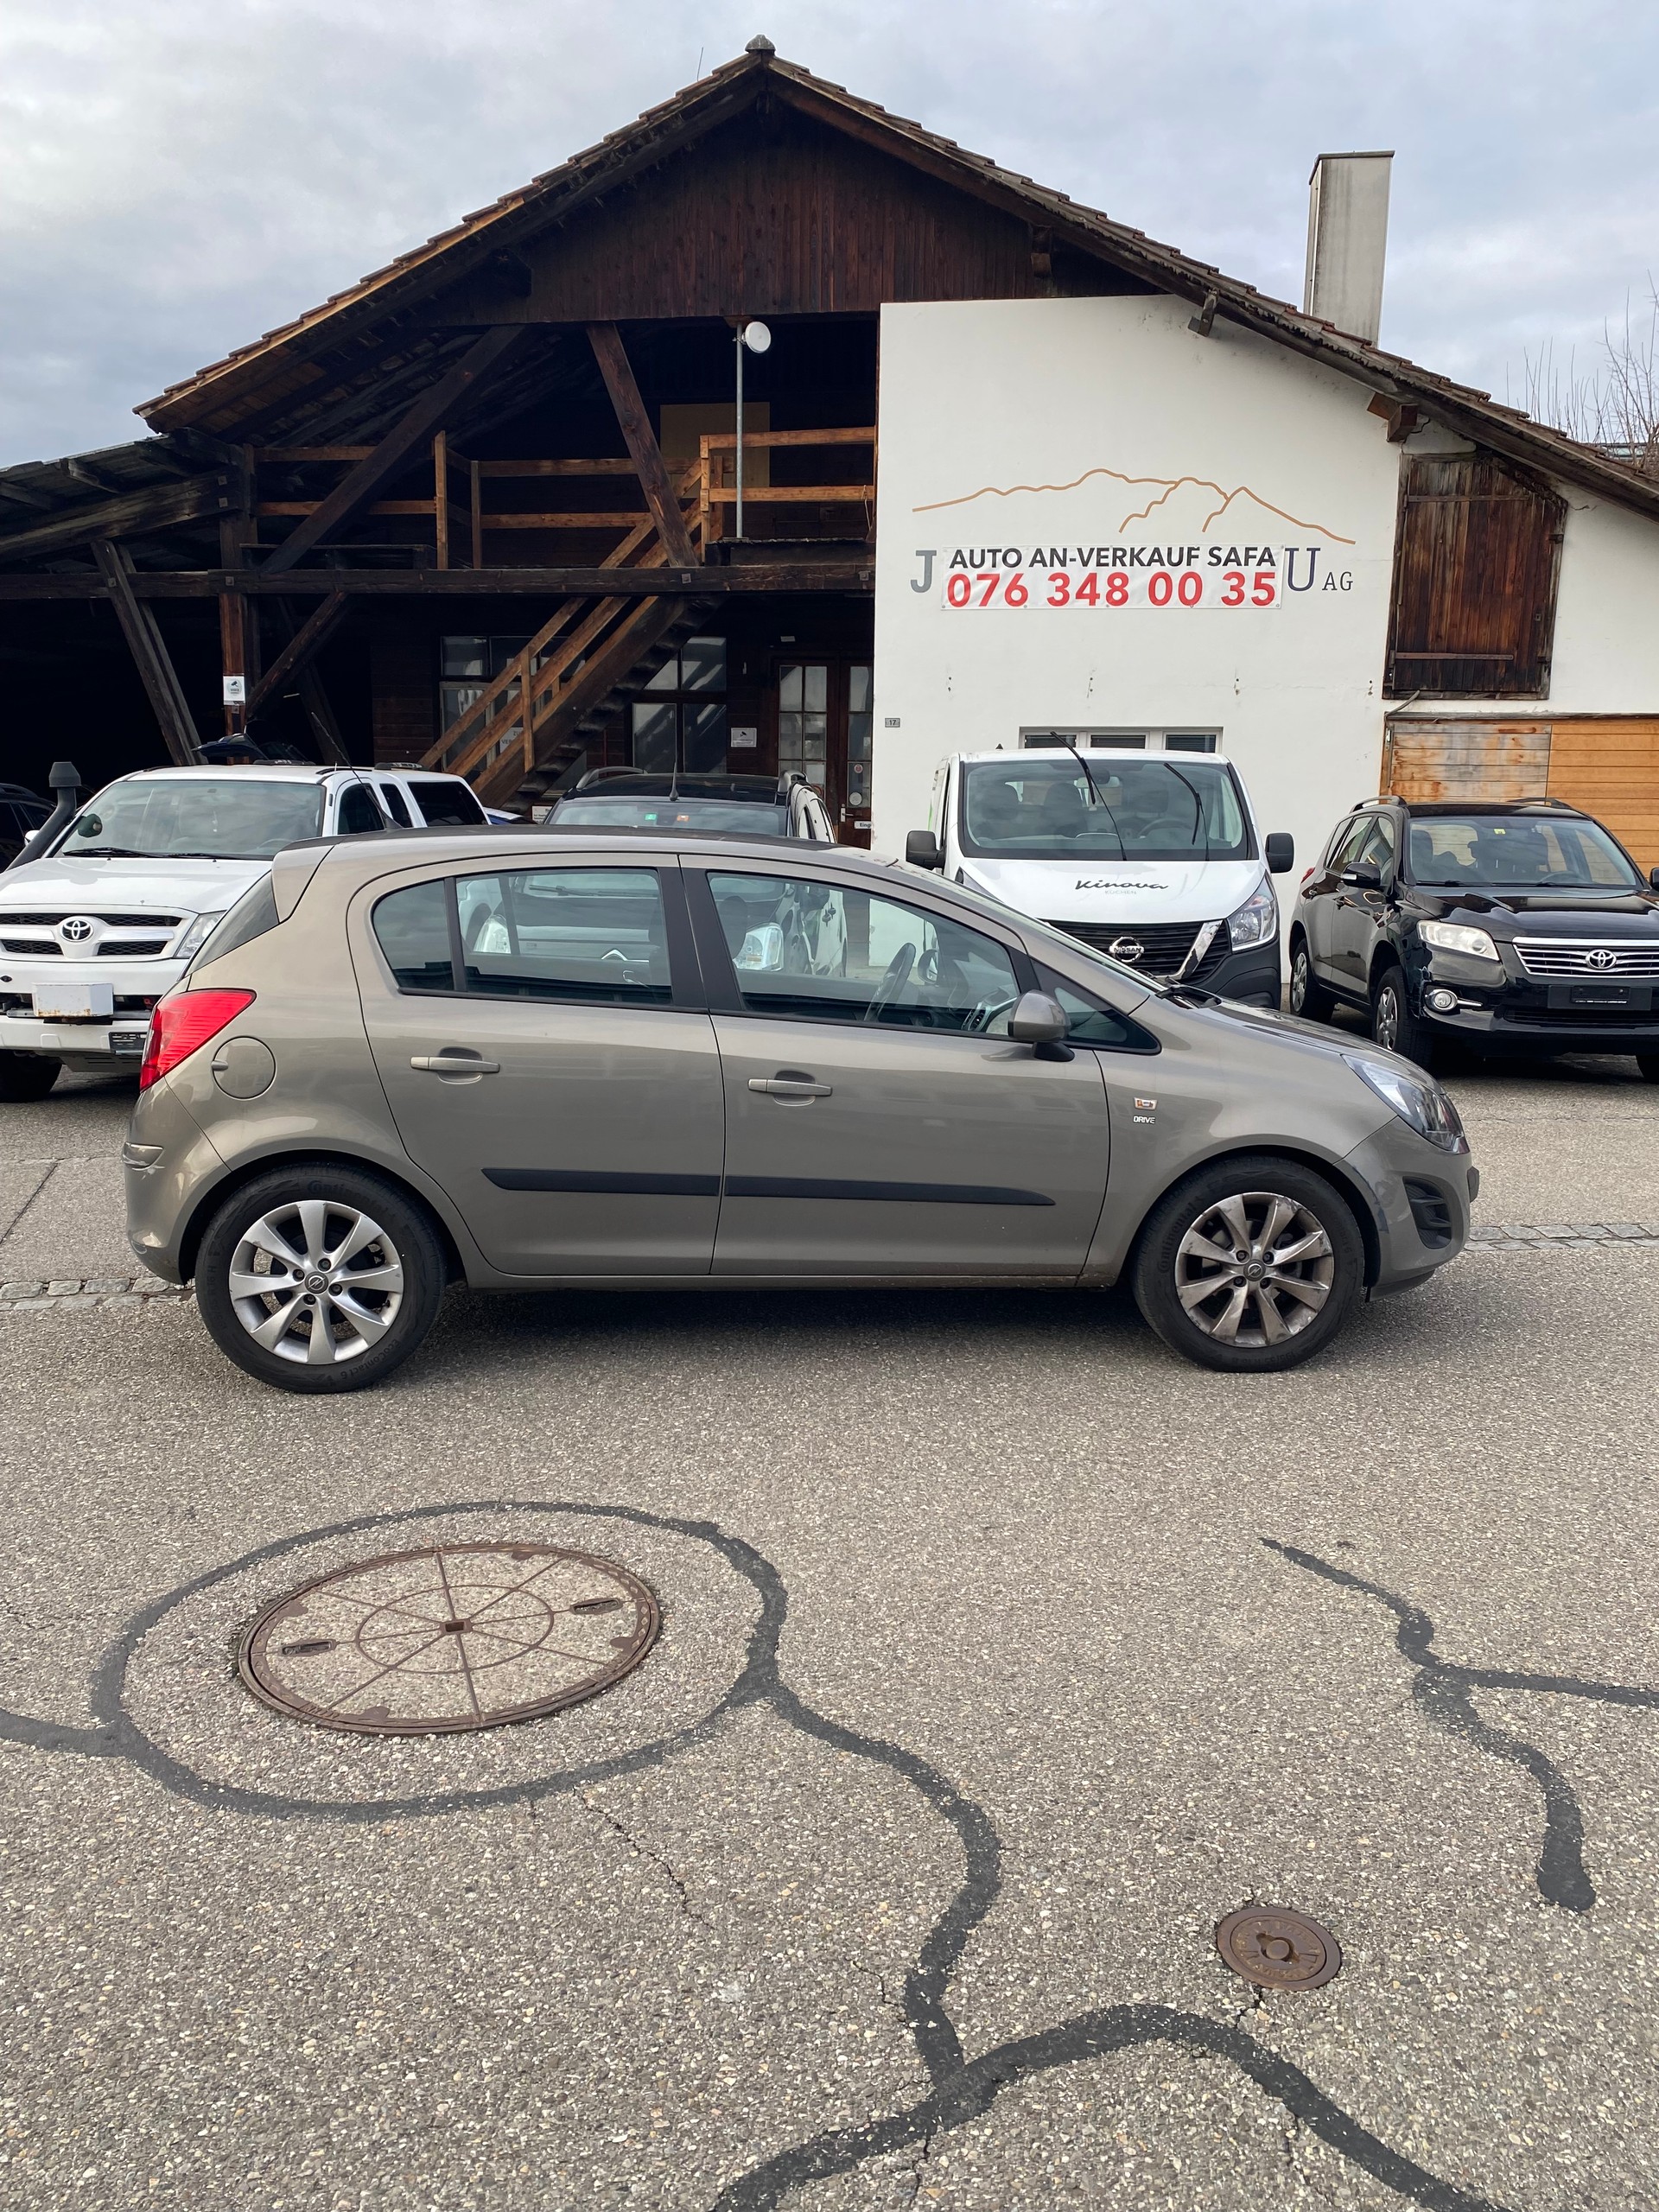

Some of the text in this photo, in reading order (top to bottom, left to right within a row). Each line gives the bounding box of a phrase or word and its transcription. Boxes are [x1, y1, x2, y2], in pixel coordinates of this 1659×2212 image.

[910, 550, 938, 594] J
[1321, 571, 1354, 591] AG
[949, 546, 1276, 569] AUTO AN-VERKAUF SAFA
[947, 571, 1276, 607] 076 348 00 35
[1075, 880, 1169, 890] Kinova
[1134, 1116, 1155, 1124] DRIVE
[1157, 1201, 1199, 1273] Continental
[348, 1337, 402, 1378] EcoContact
